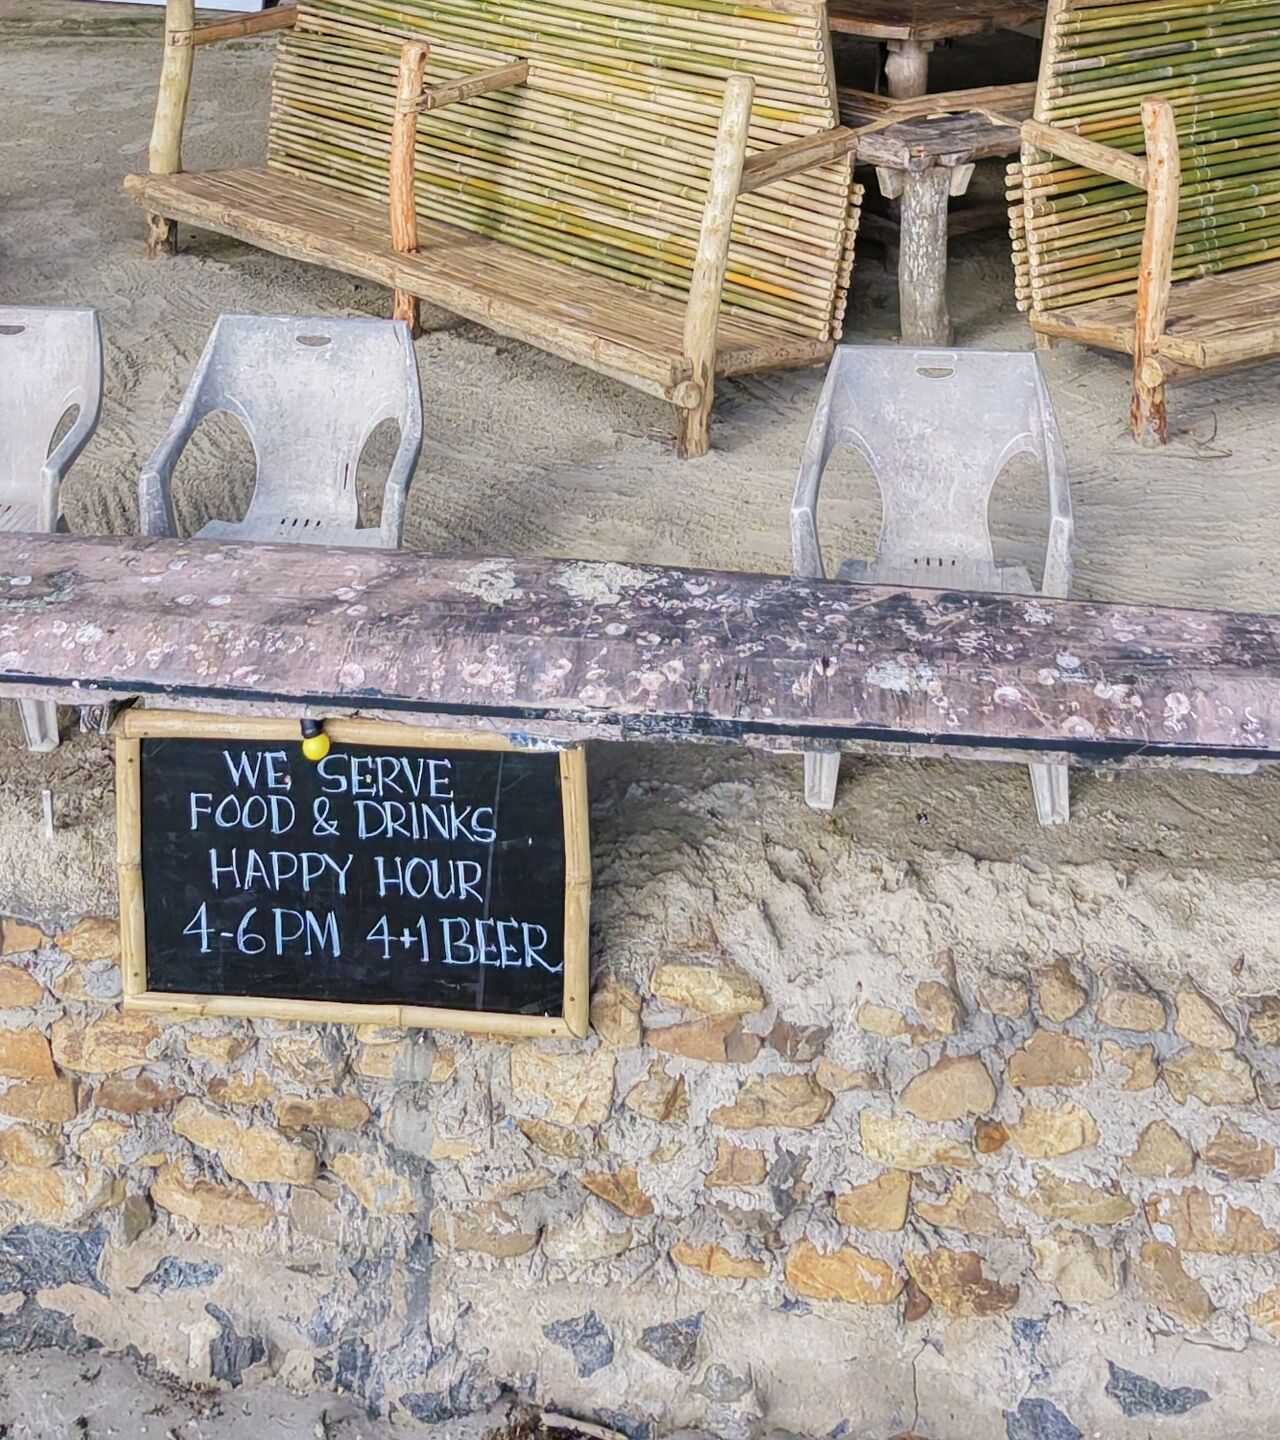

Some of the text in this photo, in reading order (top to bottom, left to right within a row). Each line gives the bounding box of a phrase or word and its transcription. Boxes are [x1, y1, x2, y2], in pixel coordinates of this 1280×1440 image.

[223, 750, 454, 798] WE SERVE
[190, 792, 497, 842] FOOD & DRINKS
[209, 848, 484, 903] HAPPY HOUR
[439, 916, 564, 973] BEER
